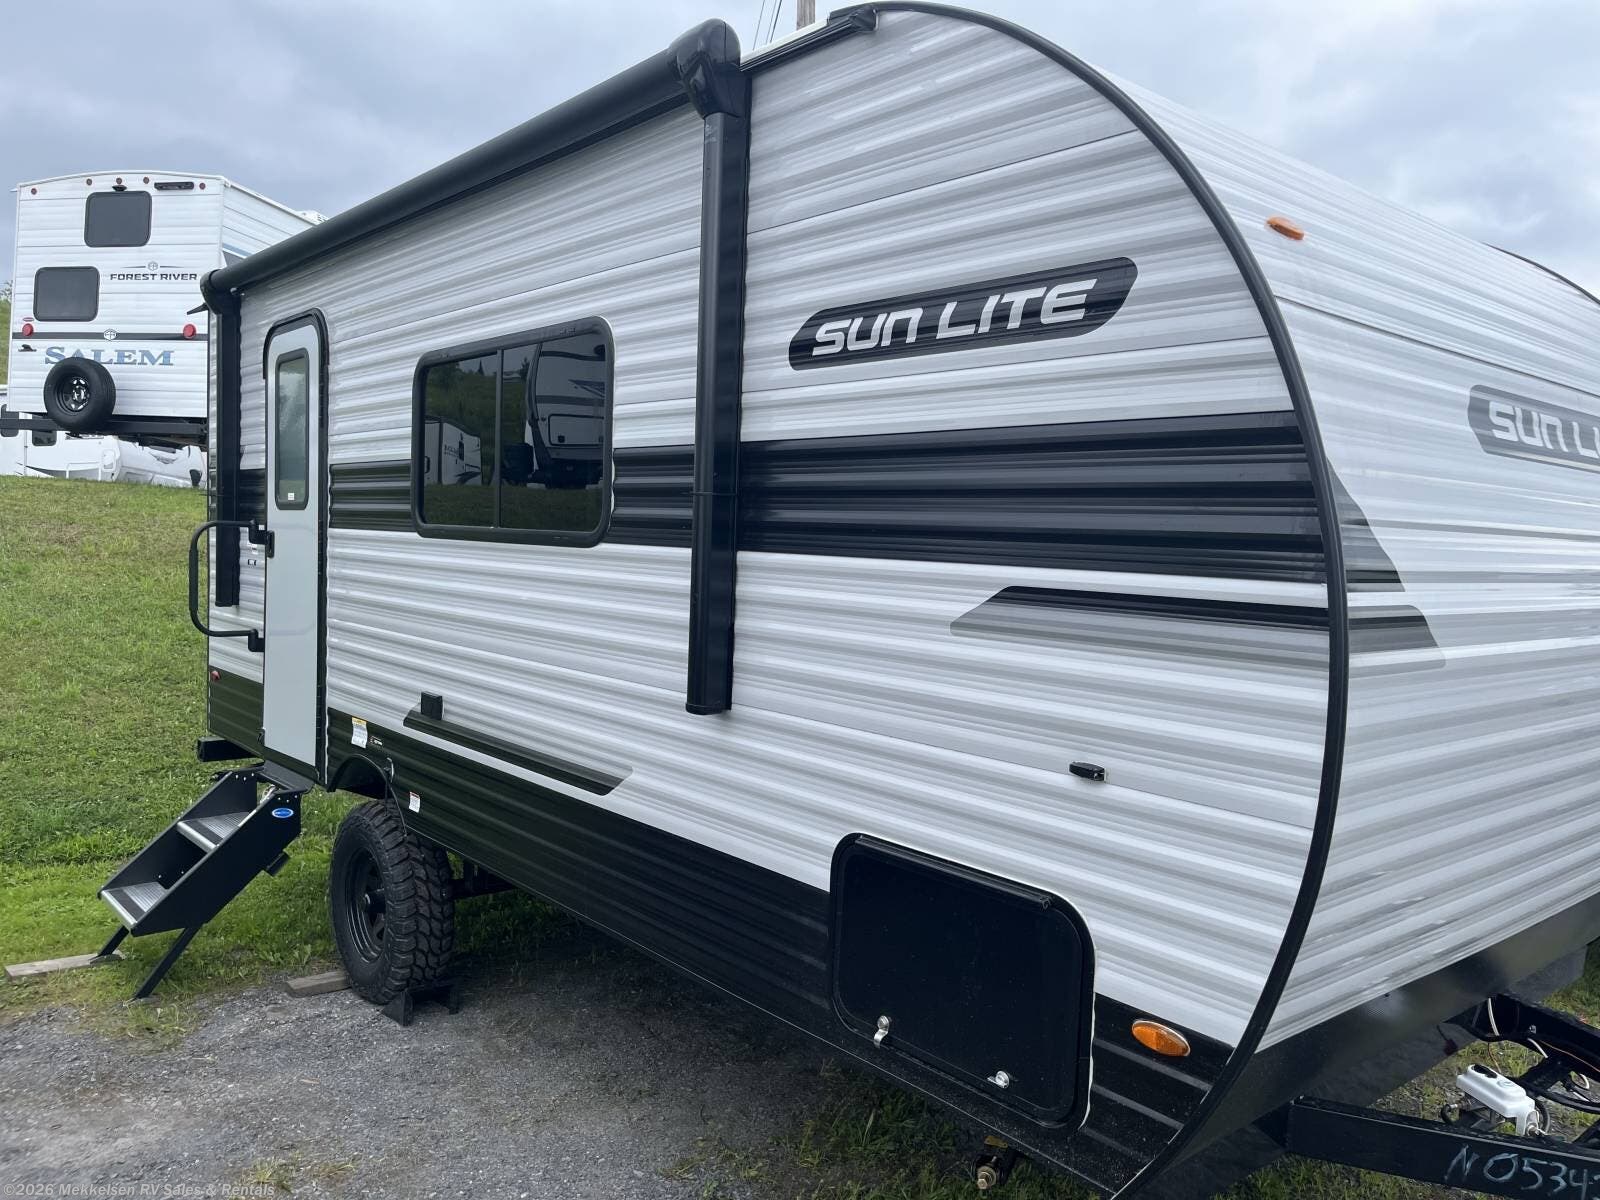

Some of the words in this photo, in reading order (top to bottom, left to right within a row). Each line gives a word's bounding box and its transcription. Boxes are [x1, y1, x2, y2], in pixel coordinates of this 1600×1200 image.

[110, 273, 158, 281] FOREST
[160, 273, 198, 281] RIVER
[812, 307, 923, 356] SUN
[936, 278, 1098, 340] LITE
[1488, 400, 1569, 453] SUN
